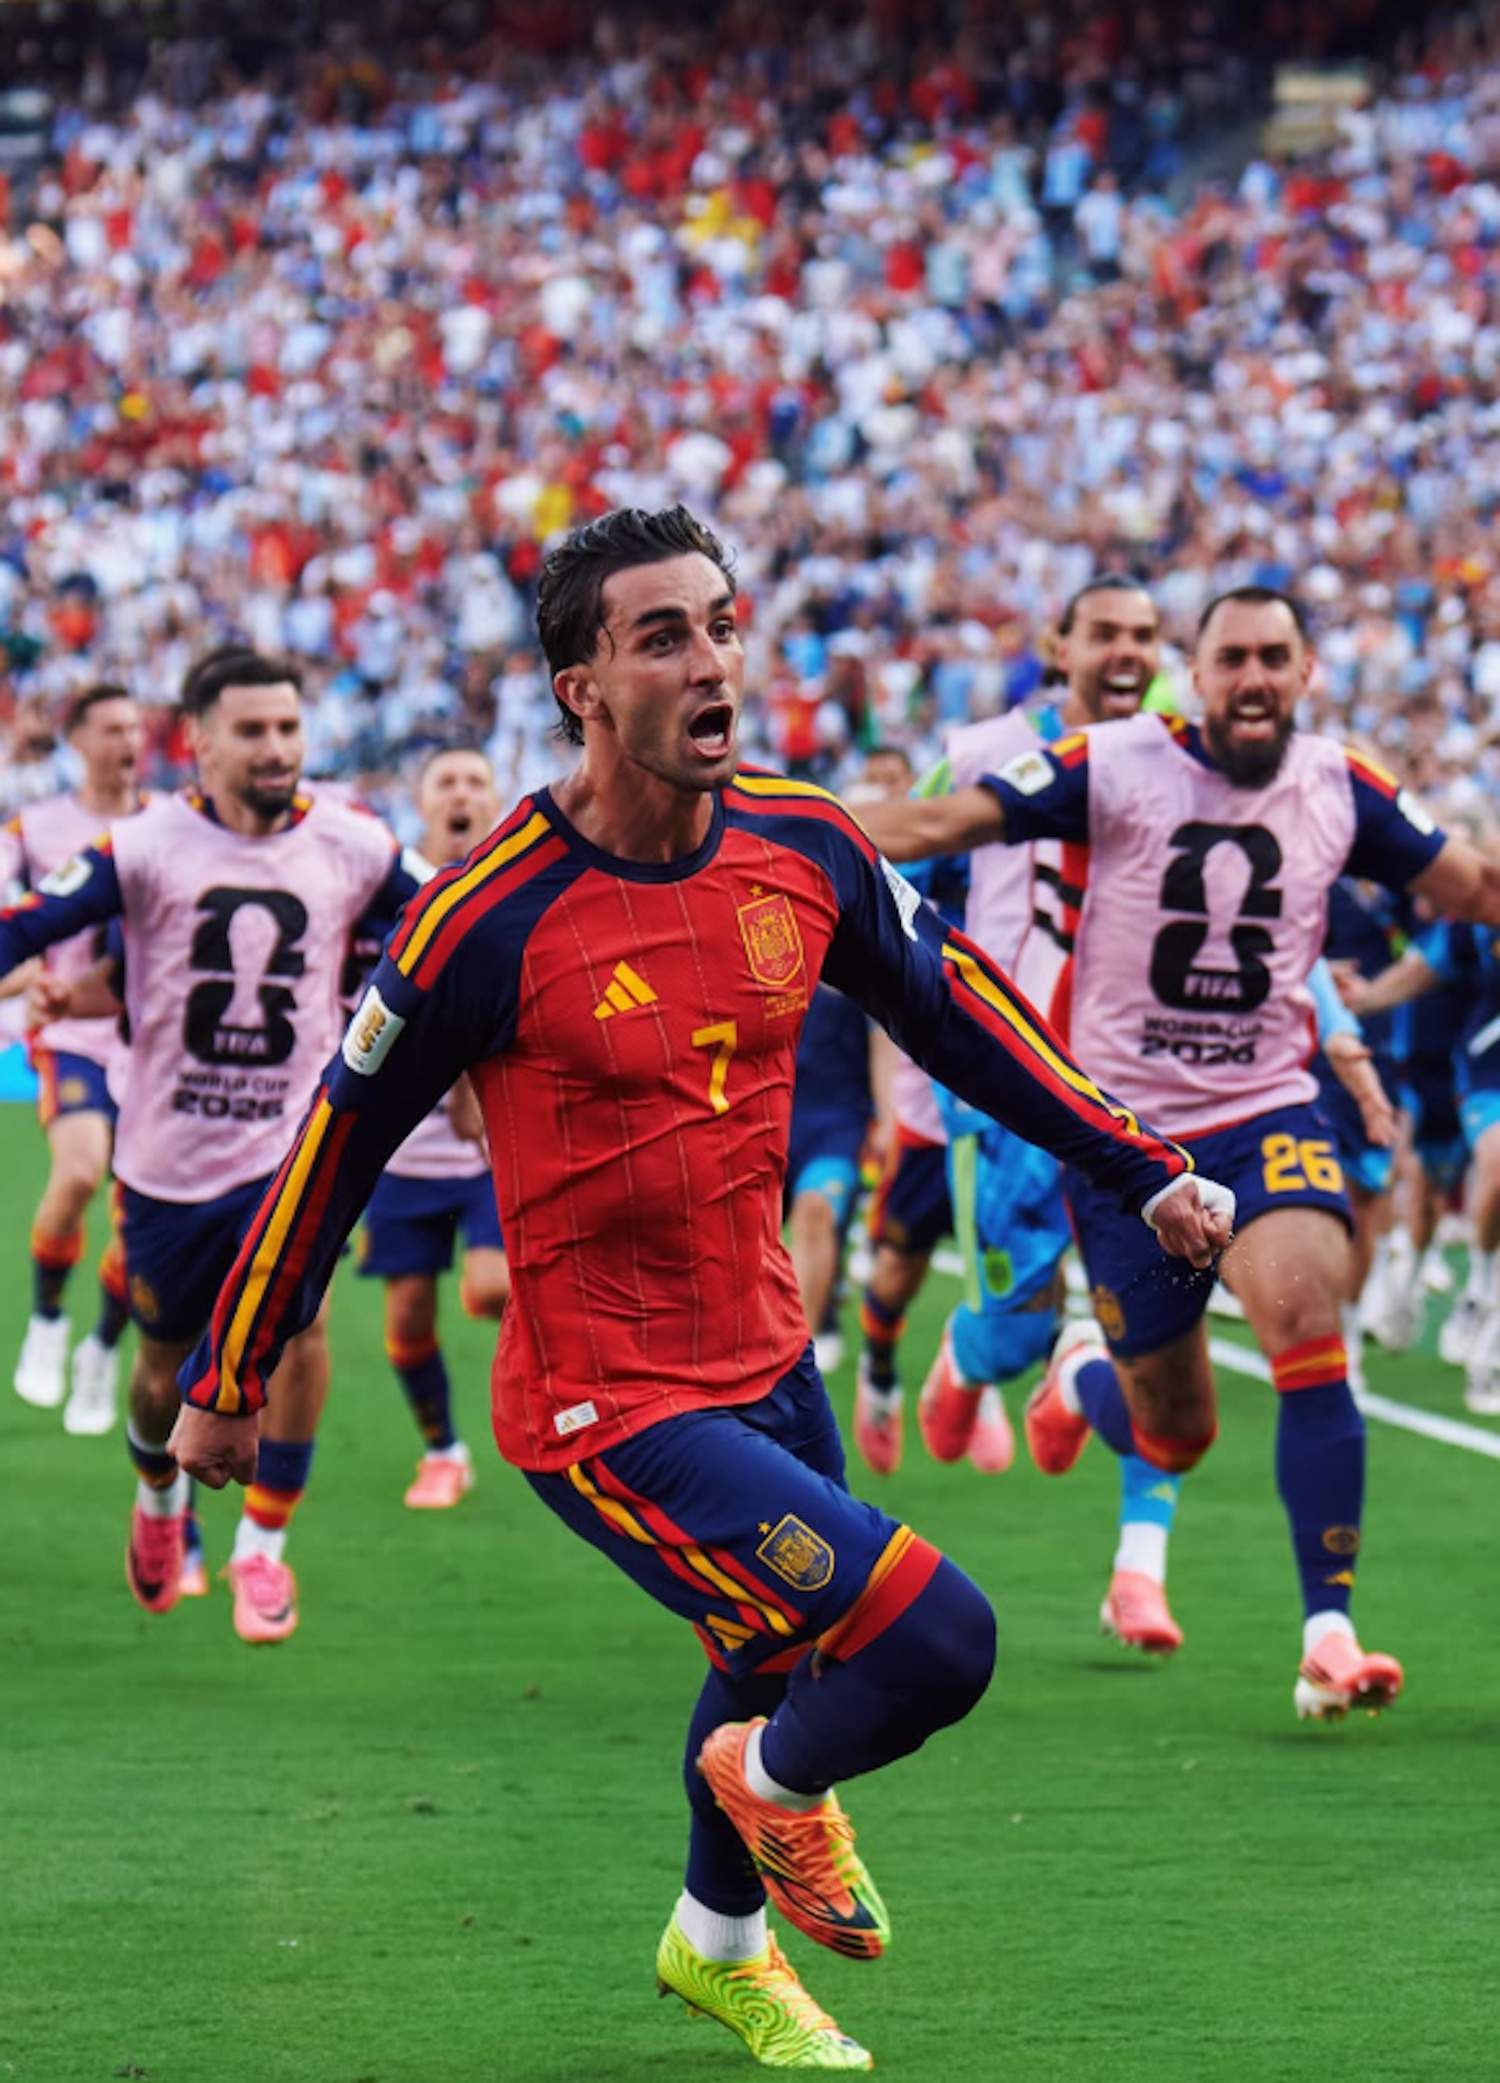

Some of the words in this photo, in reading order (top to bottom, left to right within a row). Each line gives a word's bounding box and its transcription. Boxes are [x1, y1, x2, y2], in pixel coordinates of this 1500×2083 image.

[1184, 974, 1243, 998] FIFA
[213, 1030, 268, 1054] FIFA
[1141, 1036, 1256, 1065] 2026
[691, 1020, 738, 1115] 7
[173, 1089, 284, 1121] 2026
[1261, 1133, 1345, 1194] 26
